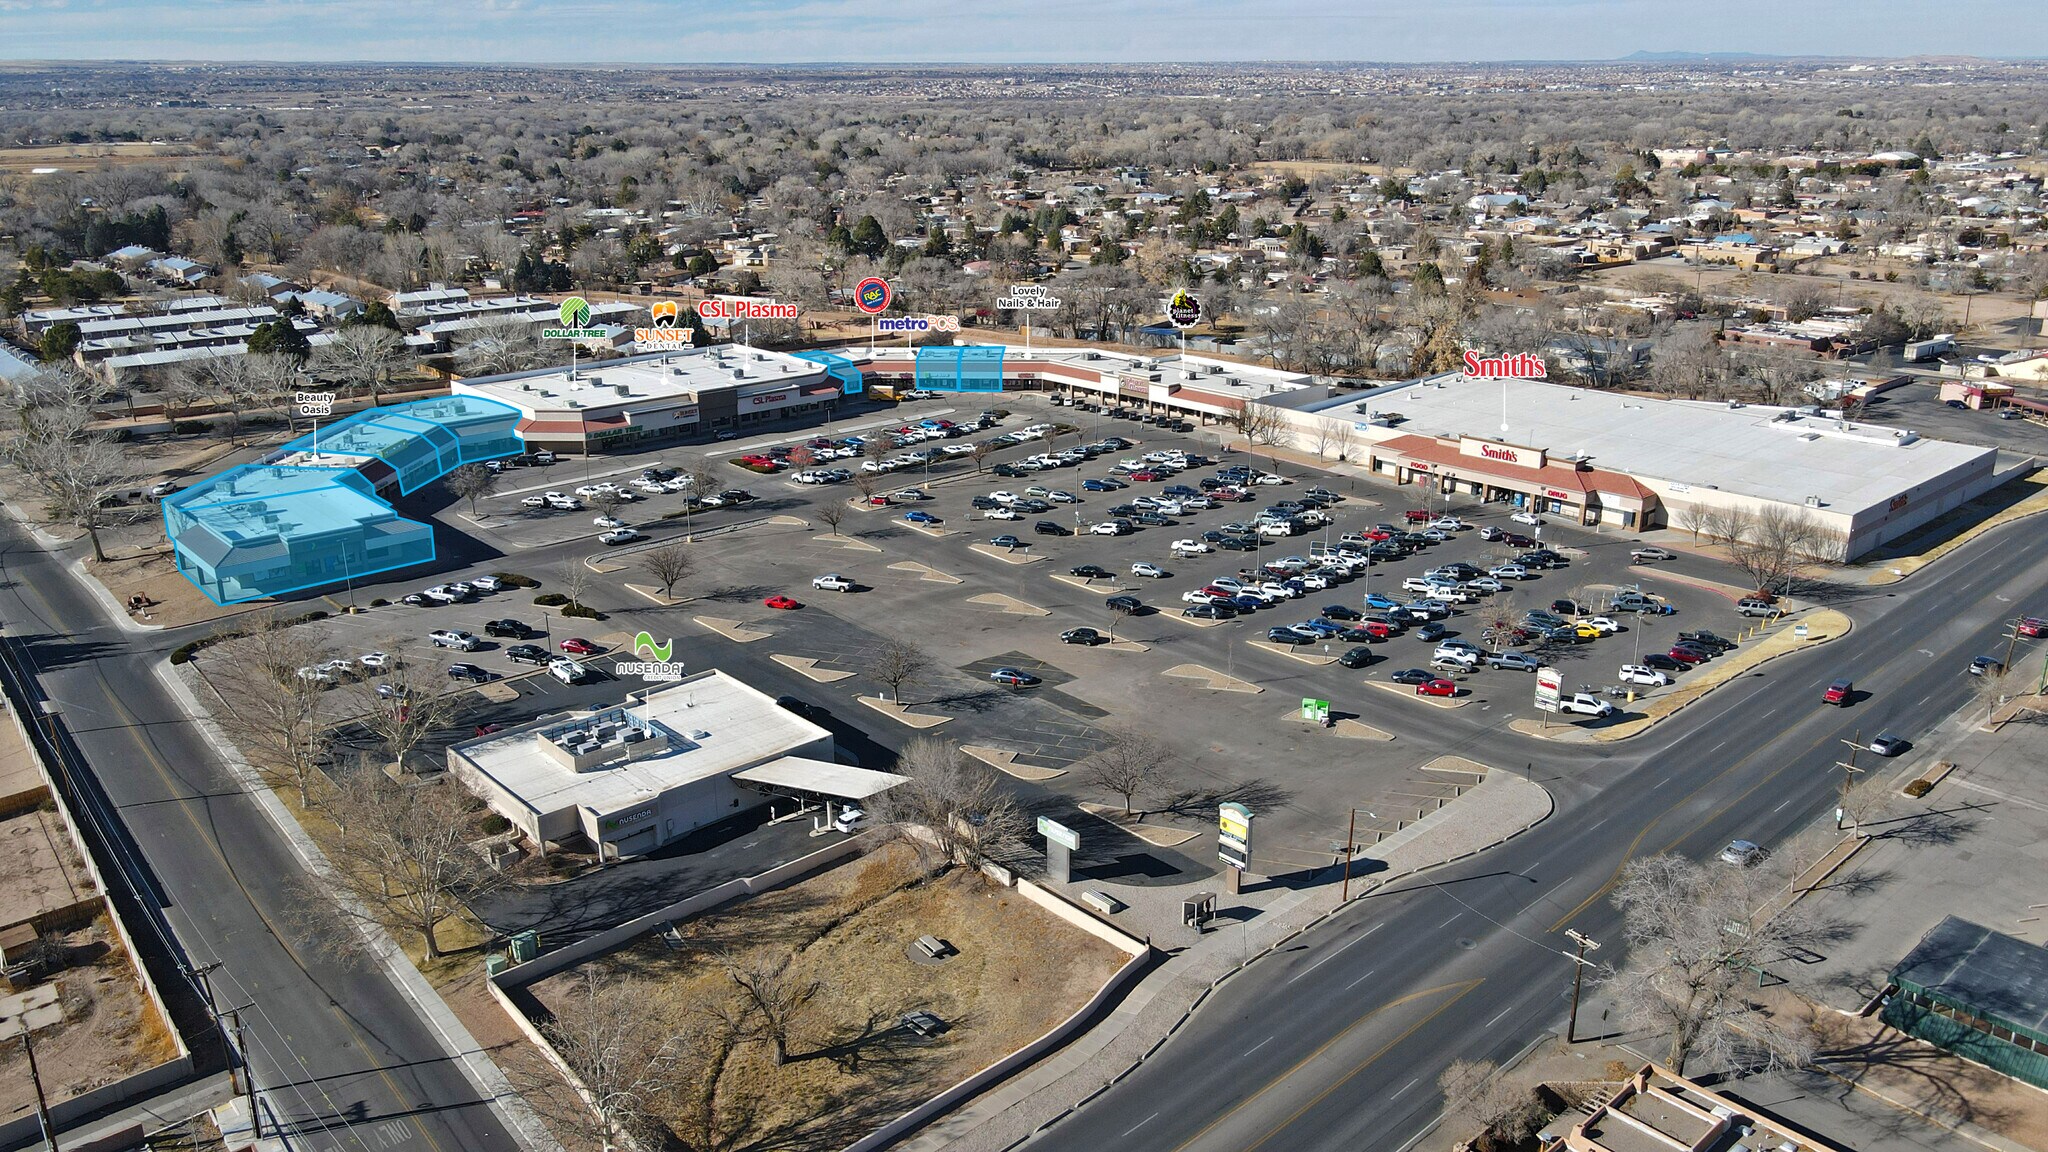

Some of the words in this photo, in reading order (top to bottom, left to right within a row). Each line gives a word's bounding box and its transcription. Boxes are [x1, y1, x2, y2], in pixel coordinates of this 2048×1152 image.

[752, 397, 764, 405] CSL
[765, 394, 786, 403] Plasma
[593, 428, 623, 439] DOLLAR
[1481, 444, 1518, 463] Smith's
[1410, 461, 1428, 471] FOOD
[1547, 489, 1568, 499] DRUG
[373, 1119, 412, 1150] ONLY
